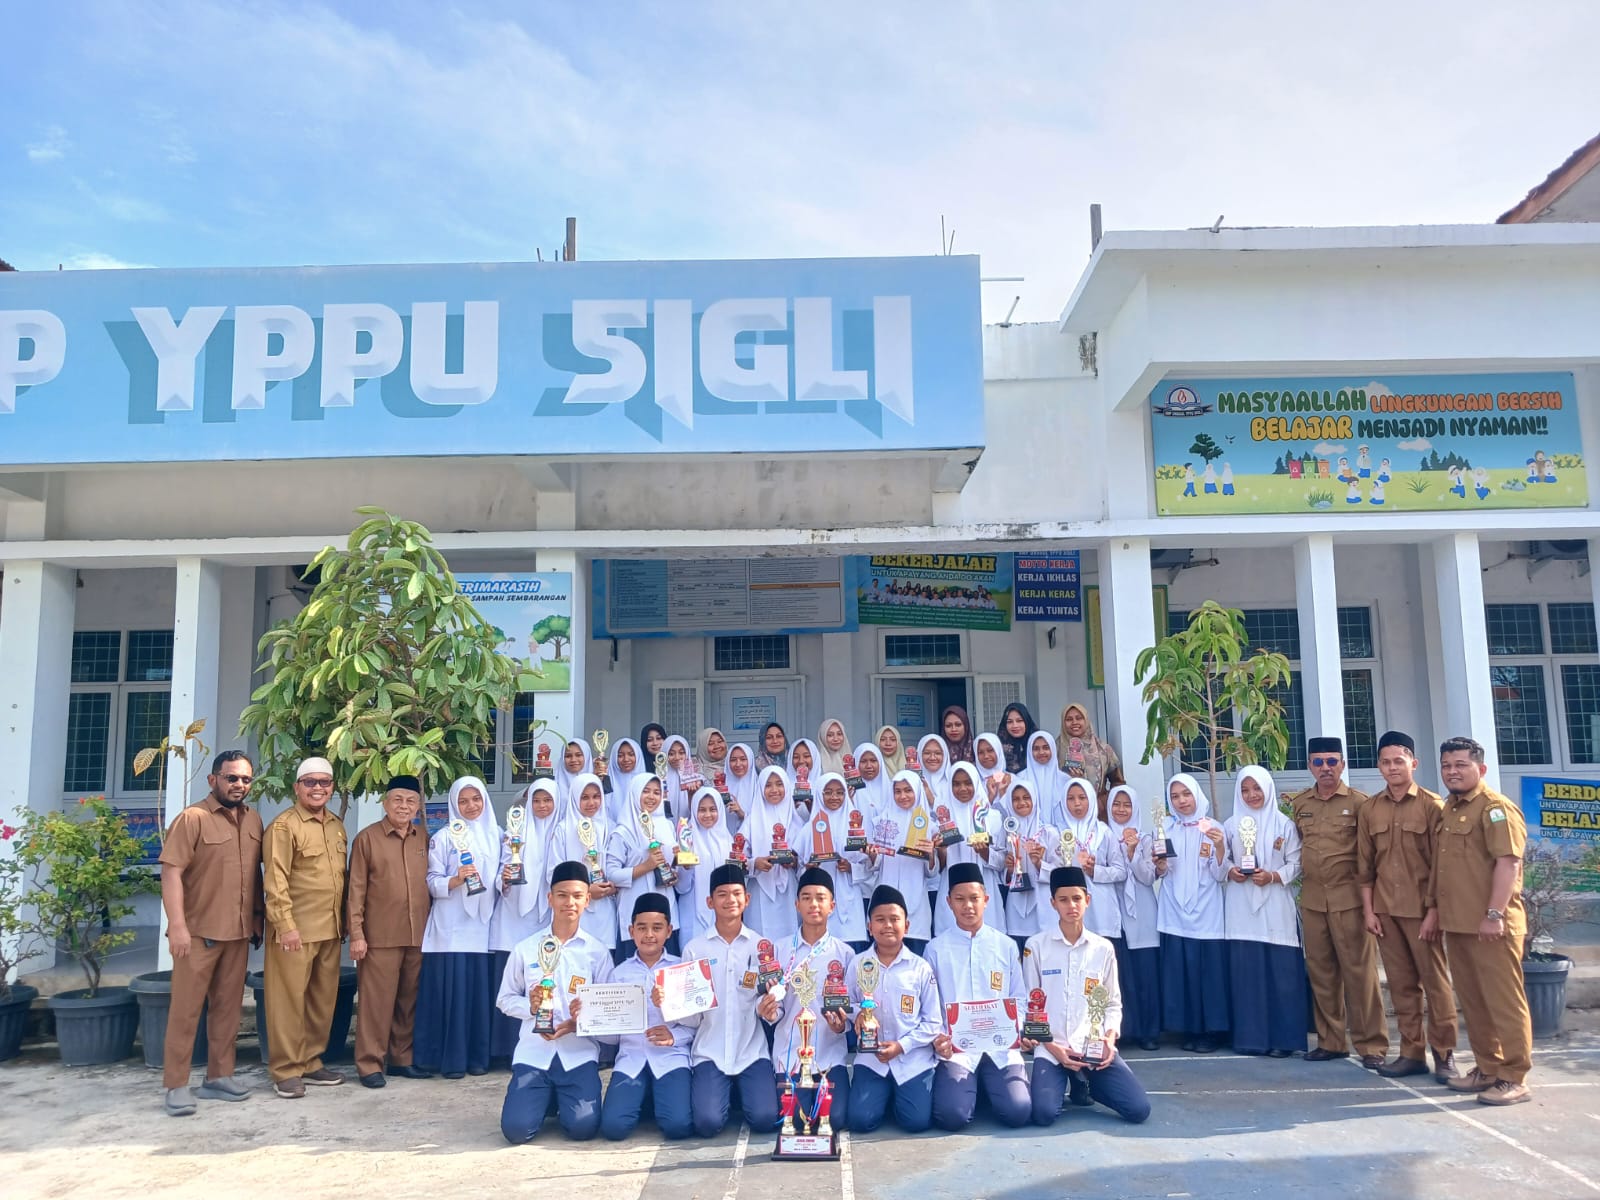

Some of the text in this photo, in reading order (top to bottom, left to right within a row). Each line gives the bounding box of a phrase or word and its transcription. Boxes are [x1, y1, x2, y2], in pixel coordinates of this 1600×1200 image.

[130, 300, 499, 411] YPPU
[561, 295, 915, 431] SIGLI
[1217, 389, 1562, 413] MASYAALLAH LINGKUNGAN BERSIH
[1251, 415, 1548, 441] BELAJAR MENJADI NYAMAN!!
[871, 554, 995, 571] BEKERJALAH
[1018, 559, 1076, 569] MOTTO KERJA
[871, 568, 898, 577] UNTUK
[1017, 573, 1077, 582] KERJA IKHLAS
[459, 581, 540, 594] ERIMAKASIH
[1019, 589, 1077, 599] KERJA KERAS
[1017, 605, 1045, 615] KERJA
[1046, 606, 1079, 615] TUNTAS
[1543, 783, 1600, 801] BERD
[1540, 800, 1567, 809] UNTUK
